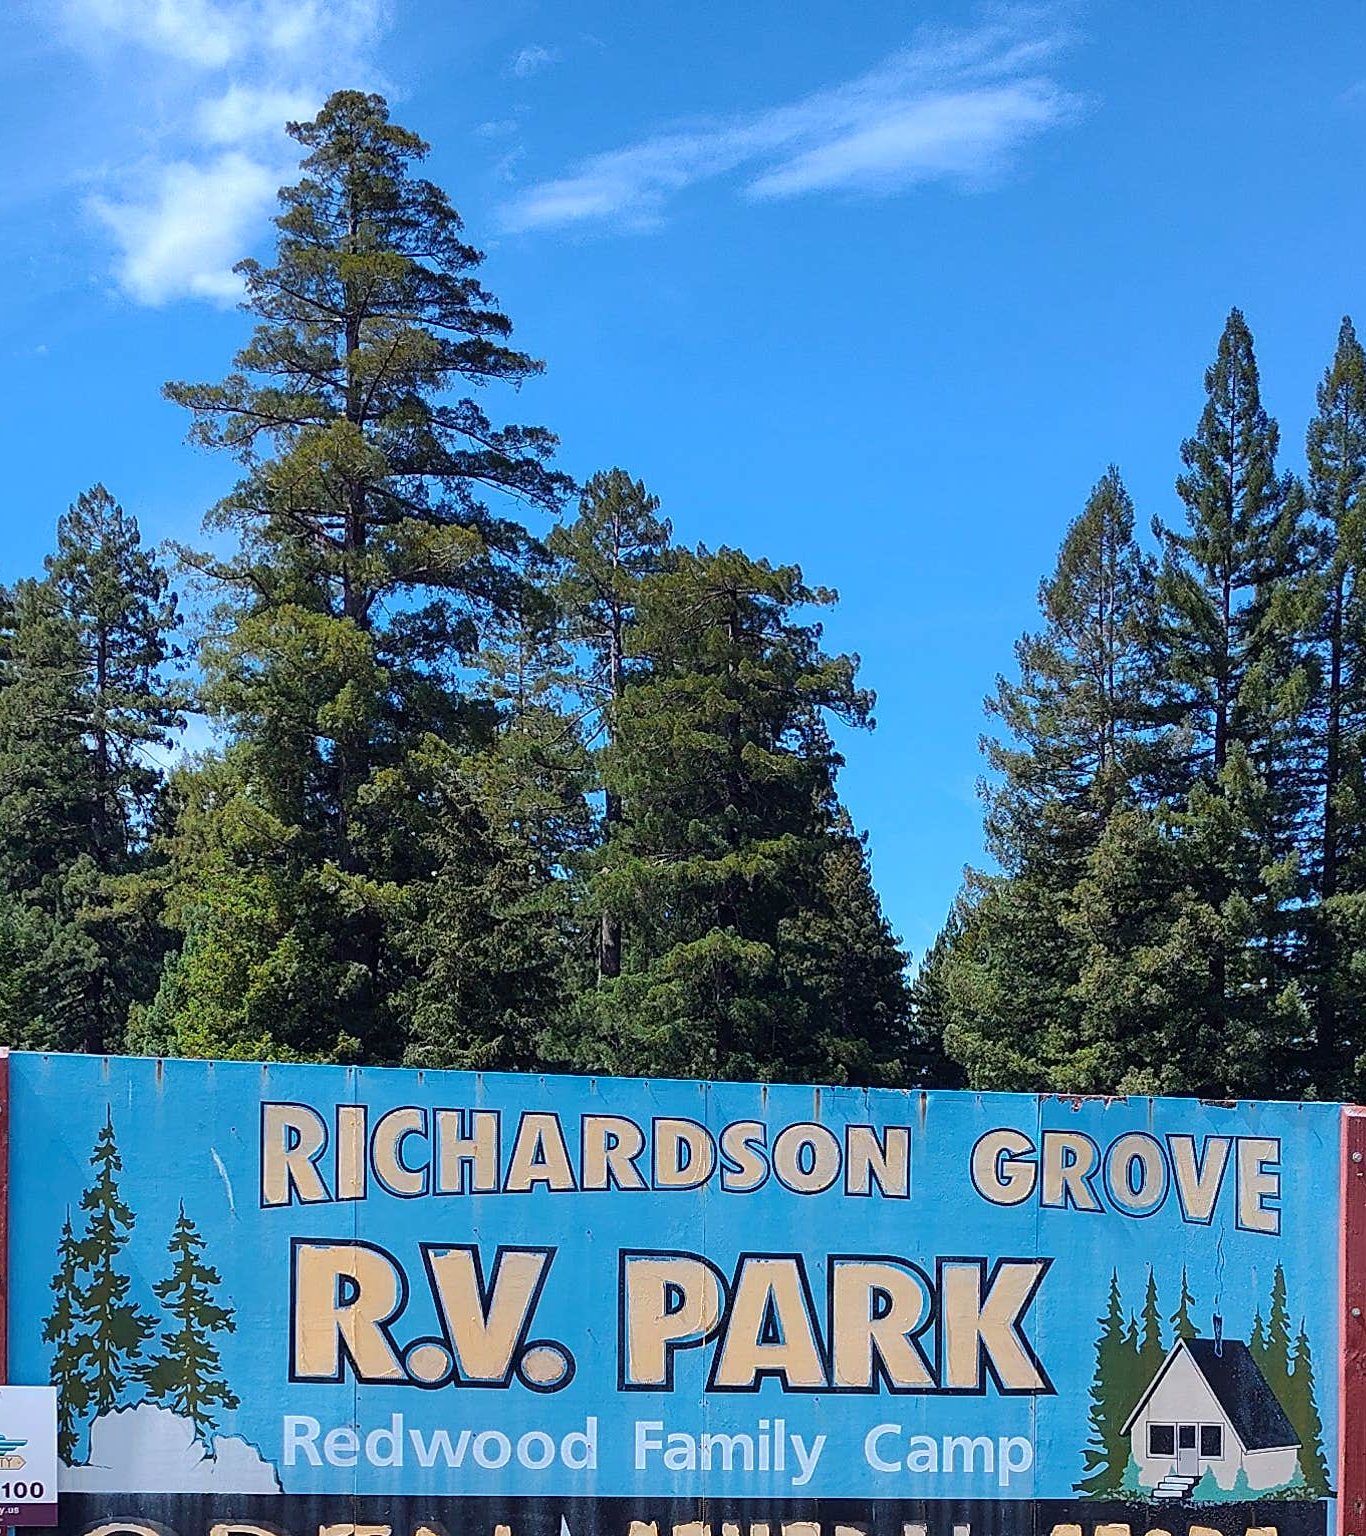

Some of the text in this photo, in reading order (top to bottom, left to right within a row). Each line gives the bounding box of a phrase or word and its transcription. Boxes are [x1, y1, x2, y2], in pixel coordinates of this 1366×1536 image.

[259, 1101, 1282, 1237] RICHARDSON GROVE
[287, 1236, 1059, 1397] R.V. PARK
[282, 1412, 1034, 1488] Redwood Family Camp
